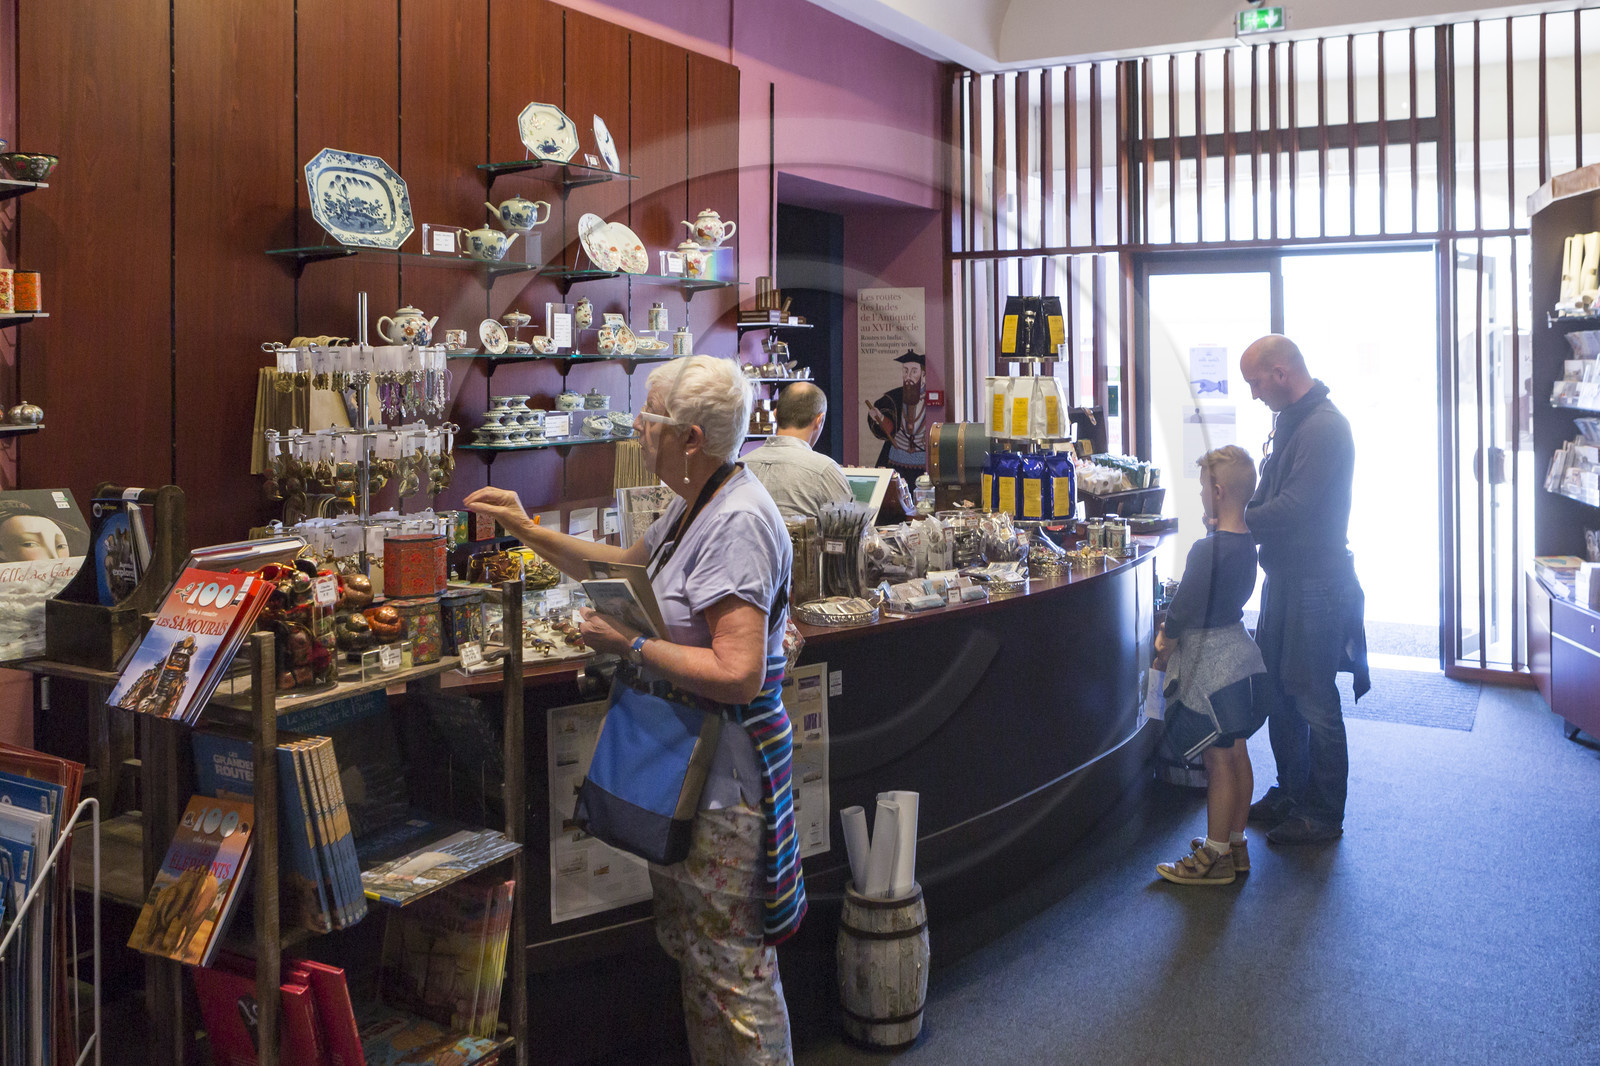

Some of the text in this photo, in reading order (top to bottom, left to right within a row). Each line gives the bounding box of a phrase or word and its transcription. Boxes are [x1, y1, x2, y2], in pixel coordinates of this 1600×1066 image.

[861, 293, 874, 301] Les
[876, 302, 899, 310] Indes
[860, 312, 917, 323] de l'Antiquité
[896, 323, 919, 331] siècle
[186, 582, 235, 609] 100
[156, 617, 170, 628] LES
[215, 764, 254, 782] ROUTE
[192, 808, 239, 838] 100
